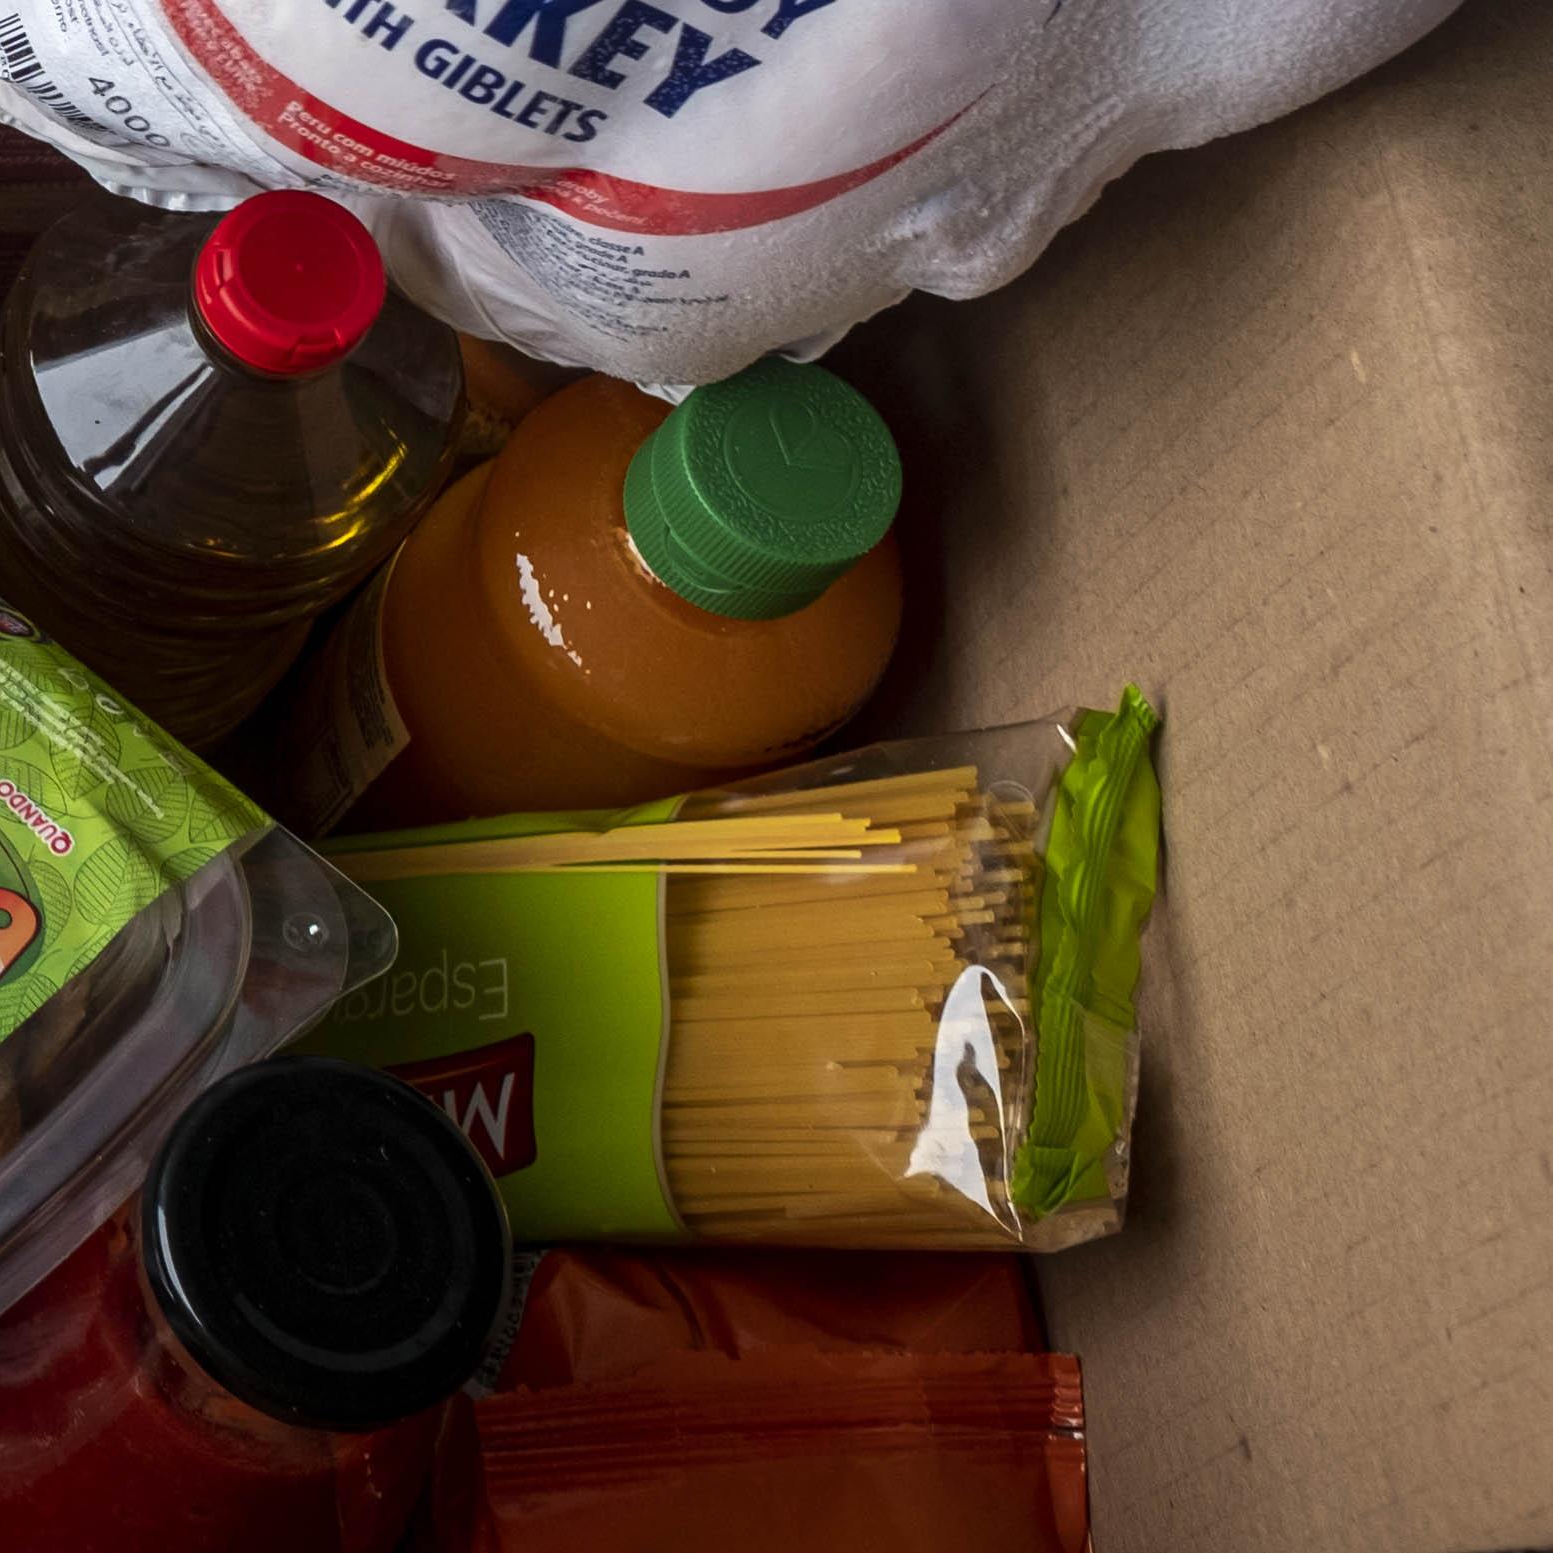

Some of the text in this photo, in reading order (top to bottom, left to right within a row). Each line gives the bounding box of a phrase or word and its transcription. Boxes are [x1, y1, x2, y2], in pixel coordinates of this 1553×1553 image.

[88, 76, 171, 148] 4000
[413, 36, 608, 145] GIBLETS
[276, 111, 341, 154] Pronto
[360, 160, 451, 188] cozinhar
[285, 100, 331, 134] Peru
[332, 133, 374, 157] com
[632, 245, 645, 256] A
[678, 268, 691, 280] A
